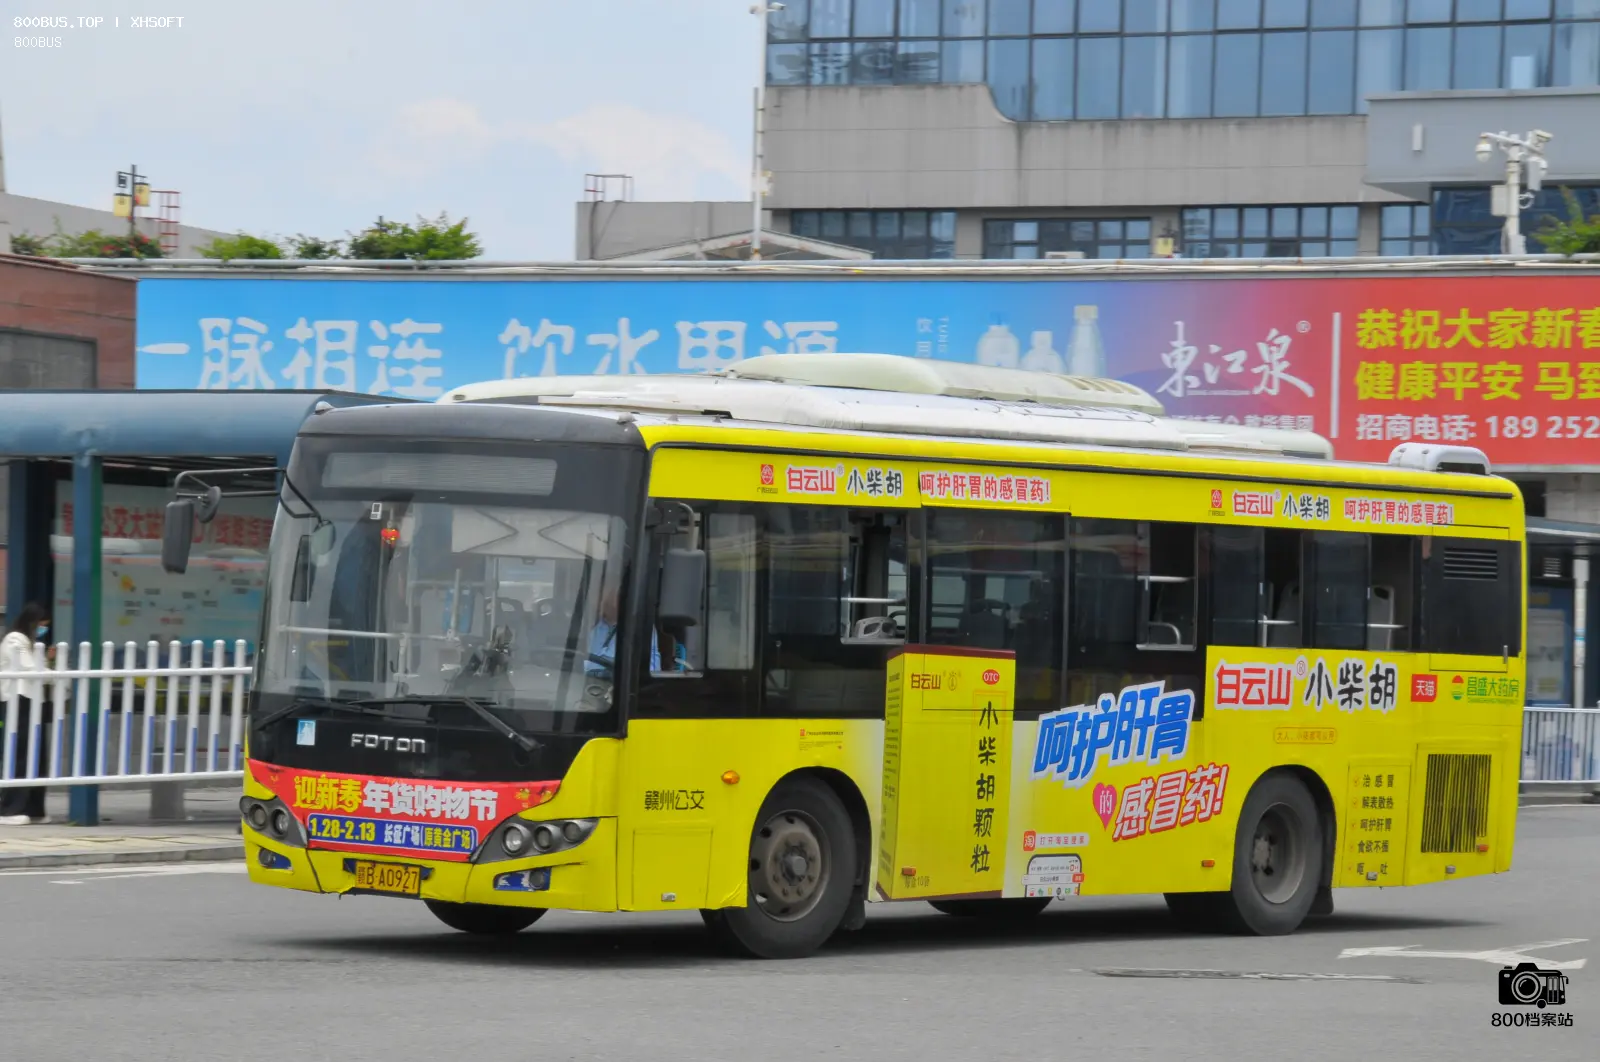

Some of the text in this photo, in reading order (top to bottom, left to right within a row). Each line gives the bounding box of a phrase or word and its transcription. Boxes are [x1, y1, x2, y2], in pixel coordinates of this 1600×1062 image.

[1355, 361, 1524, 401] 健康平安
[1355, 413, 1477, 441] 招商电话:
[1485, 415, 1540, 439] 189
[787, 467, 1051, 502] 白云山 小柴胡 呵护肝胃的感冒药!
[1232, 491, 1454, 524] 白云山 小柴胡 呵护肝胃的感冒药!
[911, 673, 942, 690] 白云山
[983, 672, 999, 682] OTC
[1216, 661, 1397, 709] 白云山 小柴胡
[1415, 680, 1435, 697] 天猫
[1466, 676, 1520, 698] 昌盛大药房
[351, 733, 426, 754] FOTON
[1031, 683, 1194, 785] 呵护肝胃
[644, 789, 705, 811] 赣州公交
[970, 700, 999, 874] 小柴胡颗粒
[1100, 764, 1229, 839] 的 感冒药!
[309, 816, 376, 842] 1.28-2.13
